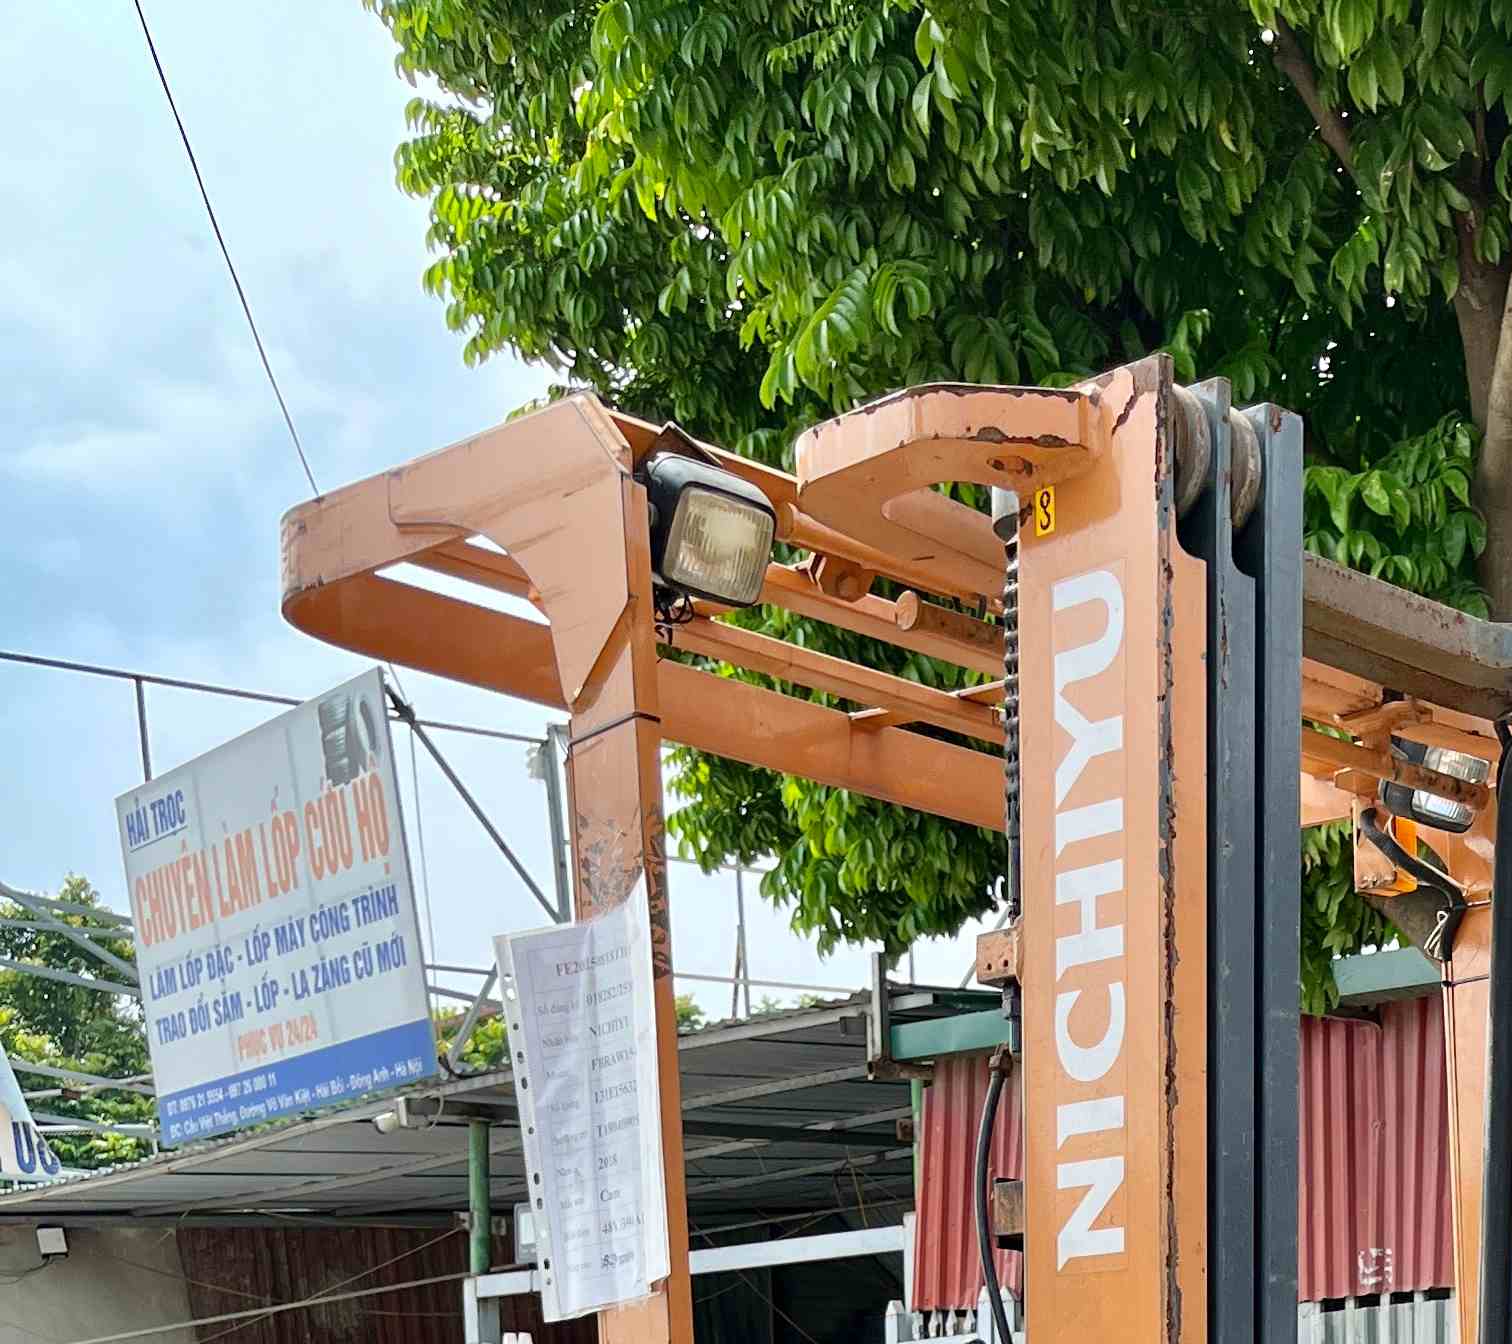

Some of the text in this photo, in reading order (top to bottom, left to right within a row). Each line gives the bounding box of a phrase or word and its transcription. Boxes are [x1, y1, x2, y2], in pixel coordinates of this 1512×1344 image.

[135, 839, 214, 946] CHUYÊN
[212, 821, 262, 919] LÀM
[259, 785, 300, 897] LỐP
[1054, 570, 1124, 1270] NICHIYU
[150, 965, 178, 1000] LÀM
[179, 949, 203, 990] LỐP
[245, 923, 271, 966] LỐP
[309, 903, 351, 943] CÔNG
[352, 884, 400, 928] TRÌNH
[156, 1010, 187, 1045] TRAO
[254, 969, 279, 1013] LỐP
[291, 969, 311, 1001] LA
[352, 942, 374, 980] CŨ
[376, 931, 407, 973] MỚI
